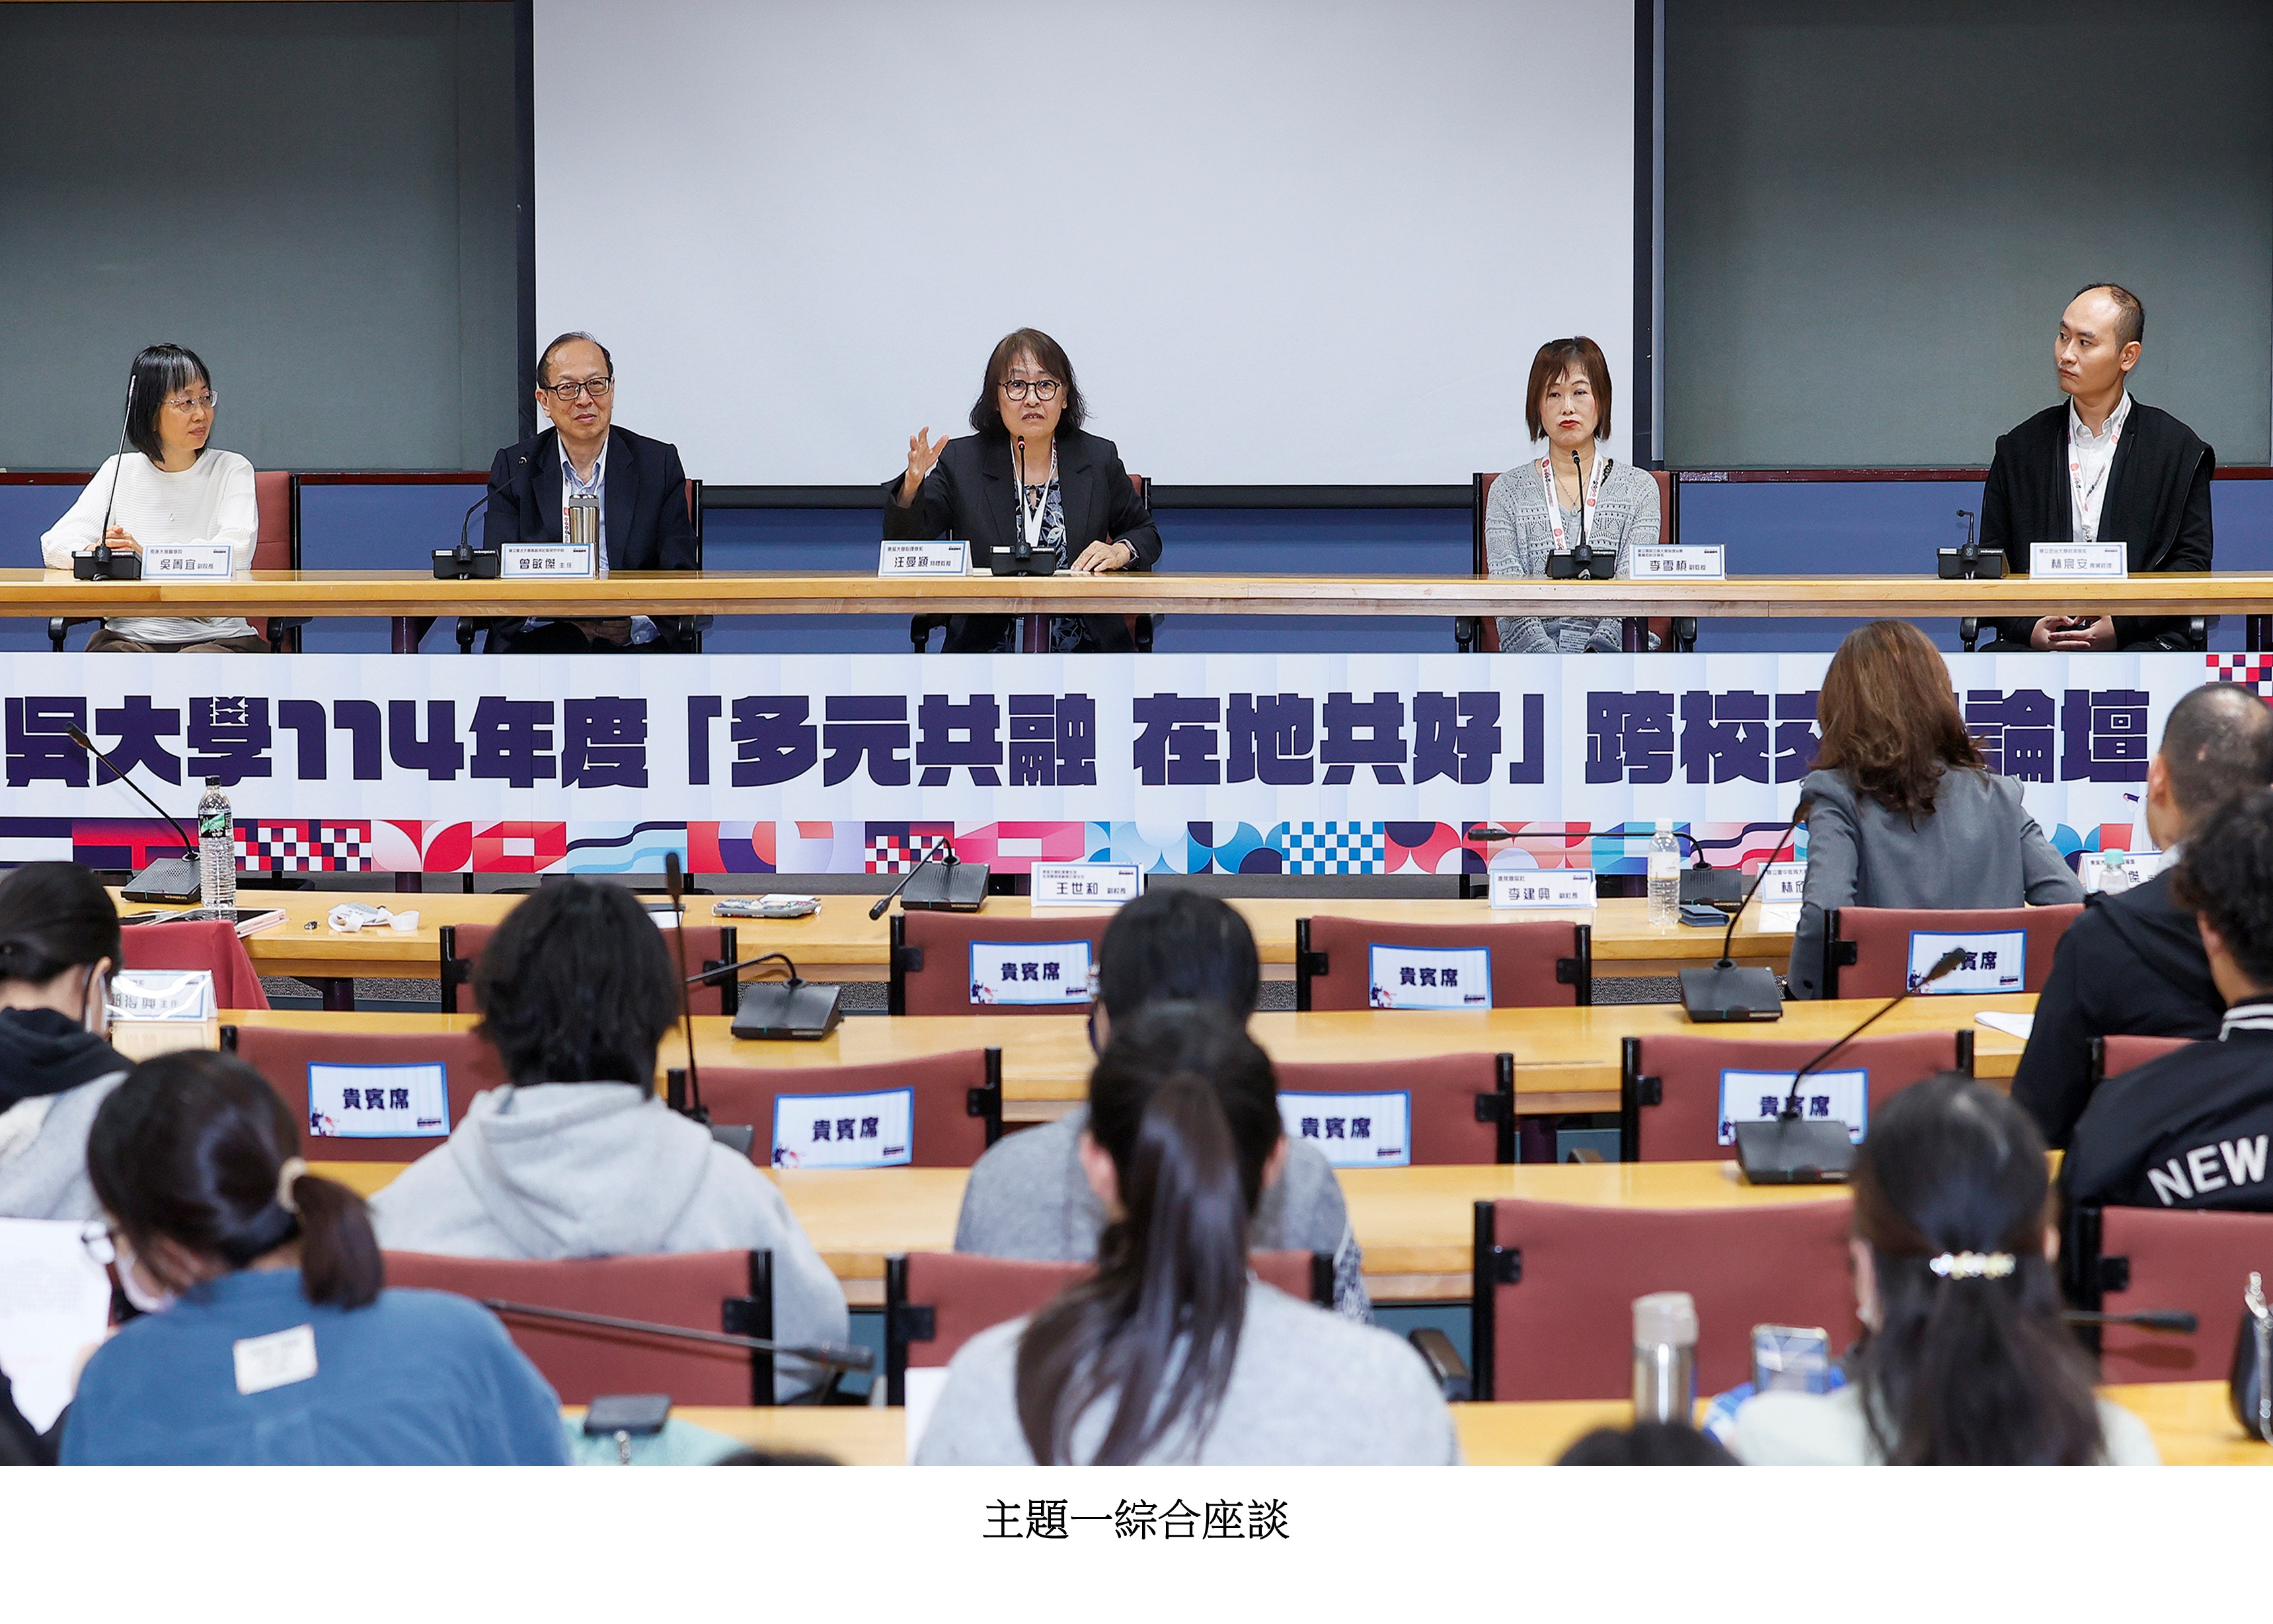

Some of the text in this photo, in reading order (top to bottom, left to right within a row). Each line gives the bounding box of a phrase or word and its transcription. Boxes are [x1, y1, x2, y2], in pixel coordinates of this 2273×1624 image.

[160, 559, 196, 570] 吳菁宜
[520, 559, 556, 570] 曾敏傑
[894, 556, 929, 568] 汪曼穎
[1056, 882, 1098, 895] 王世和
[1508, 888, 1551, 901] 李建興
[1941, 950, 1997, 971] 賓席
[1001, 962, 1061, 982] 貴賓席
[1399, 966, 1459, 987] 貴賓席
[342, 1087, 410, 1110] 貴賓席
[1759, 1095, 1830, 1117] 貴賓席
[812, 1115, 880, 1142] 貴賓席
[1301, 1117, 1371, 1140] 貴賓席
[2147, 1134, 2270, 1207] NEW
